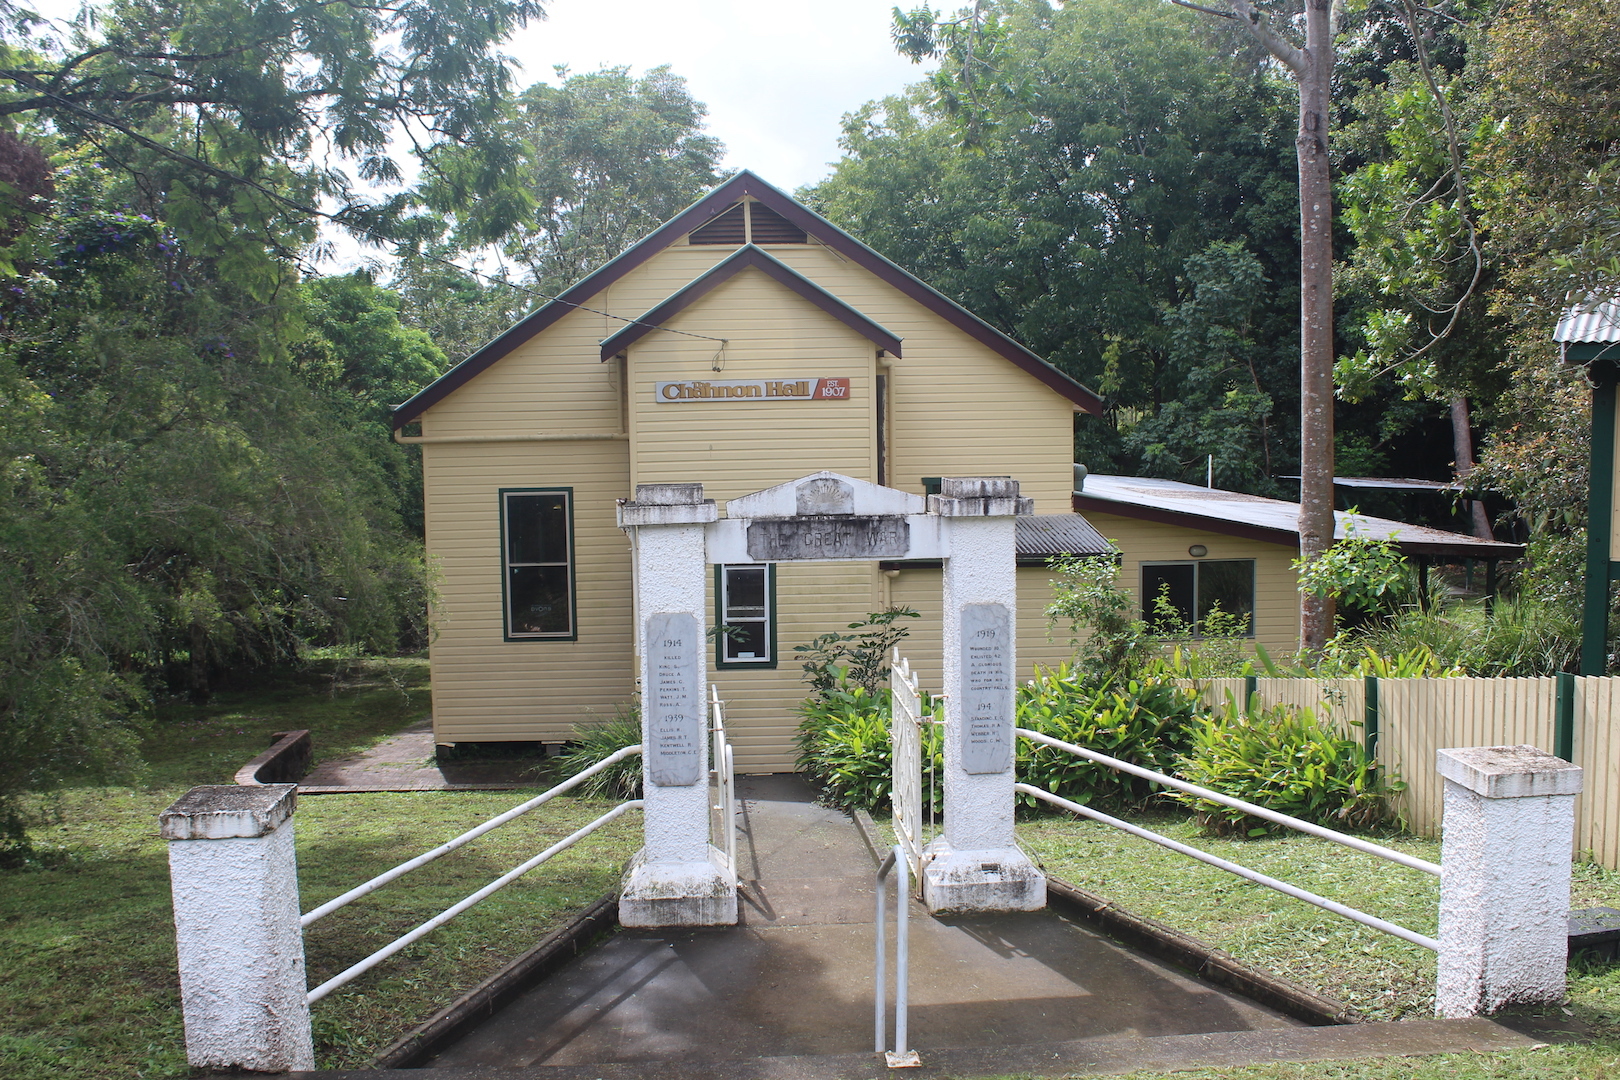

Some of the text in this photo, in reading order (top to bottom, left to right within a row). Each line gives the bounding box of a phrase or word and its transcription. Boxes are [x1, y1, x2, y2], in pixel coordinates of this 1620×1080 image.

[662, 381, 811, 400] Channon Hall
[821, 387, 846, 397] 1907
[760, 531, 898, 547] THE GREAT WAR
[977, 630, 996, 639] 1919
[663, 639, 682, 647] 1914
[665, 714, 684, 722] 1939
